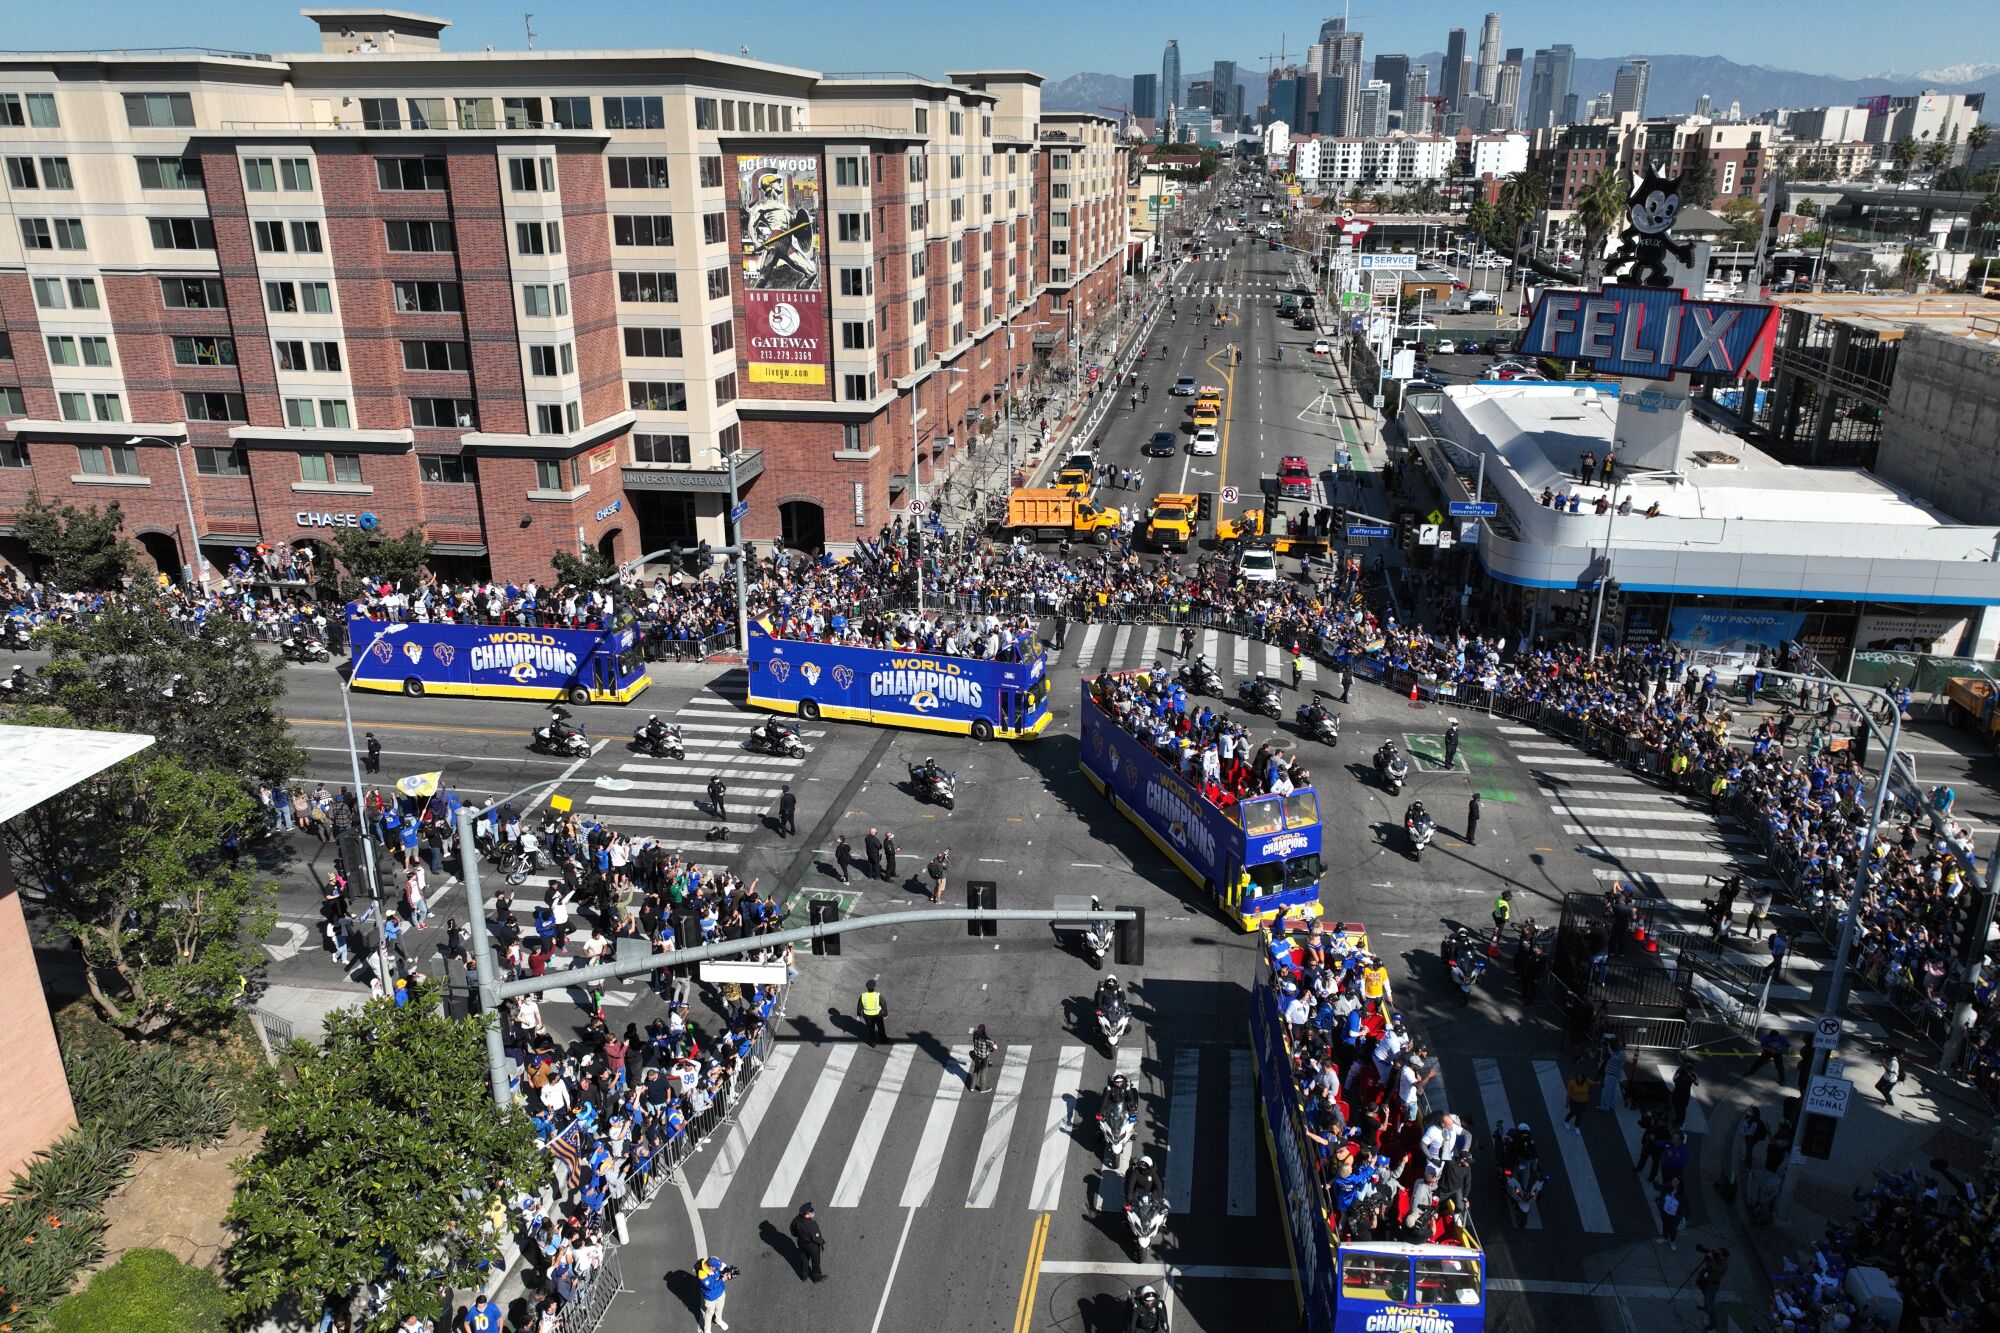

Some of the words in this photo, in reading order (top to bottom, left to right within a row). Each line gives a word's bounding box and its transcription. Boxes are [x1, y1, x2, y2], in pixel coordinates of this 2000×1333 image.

[739, 158, 817, 172] HOLLYWOOD
[1641, 239, 1661, 247] FELIX
[1374, 256, 1414, 264] SERVICE
[750, 293, 769, 302] NOW
[775, 293, 816, 303] LEASING
[1541, 297, 1741, 371] FELIX
[751, 336, 819, 349] GATEWAY
[760, 350, 812, 361] 213.279.3369
[765, 367, 809, 379] livegw.com
[623, 474, 678, 486] UNIVERSITY
[680, 476, 726, 487] GATEWAY
[596, 502, 618, 521] CHASE
[296, 512, 359, 528] CHASE
[1351, 528, 1381, 536] Jefferson
[1700, 614, 1725, 624] MUY
[1729, 615, 1785, 626] PRONTO...
[488, 632, 556, 646] WORLD
[1803, 635, 1847, 643] ABIERTO
[471, 643, 577, 677] CHAMPIONS
[891, 658, 961, 676] WORLD
[870, 669, 983, 709] CHAMPIONS
[1159, 772, 1203, 818] WORLD
[1146, 780, 1215, 868] CHAMPIONS
[1272, 832, 1301, 842] WORLD
[1262, 837, 1308, 856] CHAMPIONS
[684, 1073, 695, 1084] 99
[1808, 1097, 1843, 1112] SIGNAL
[1384, 1305, 1441, 1319] WORLD
[474, 1315, 488, 1331] 10
[1365, 1315, 1454, 1333] CHAMPIONS
